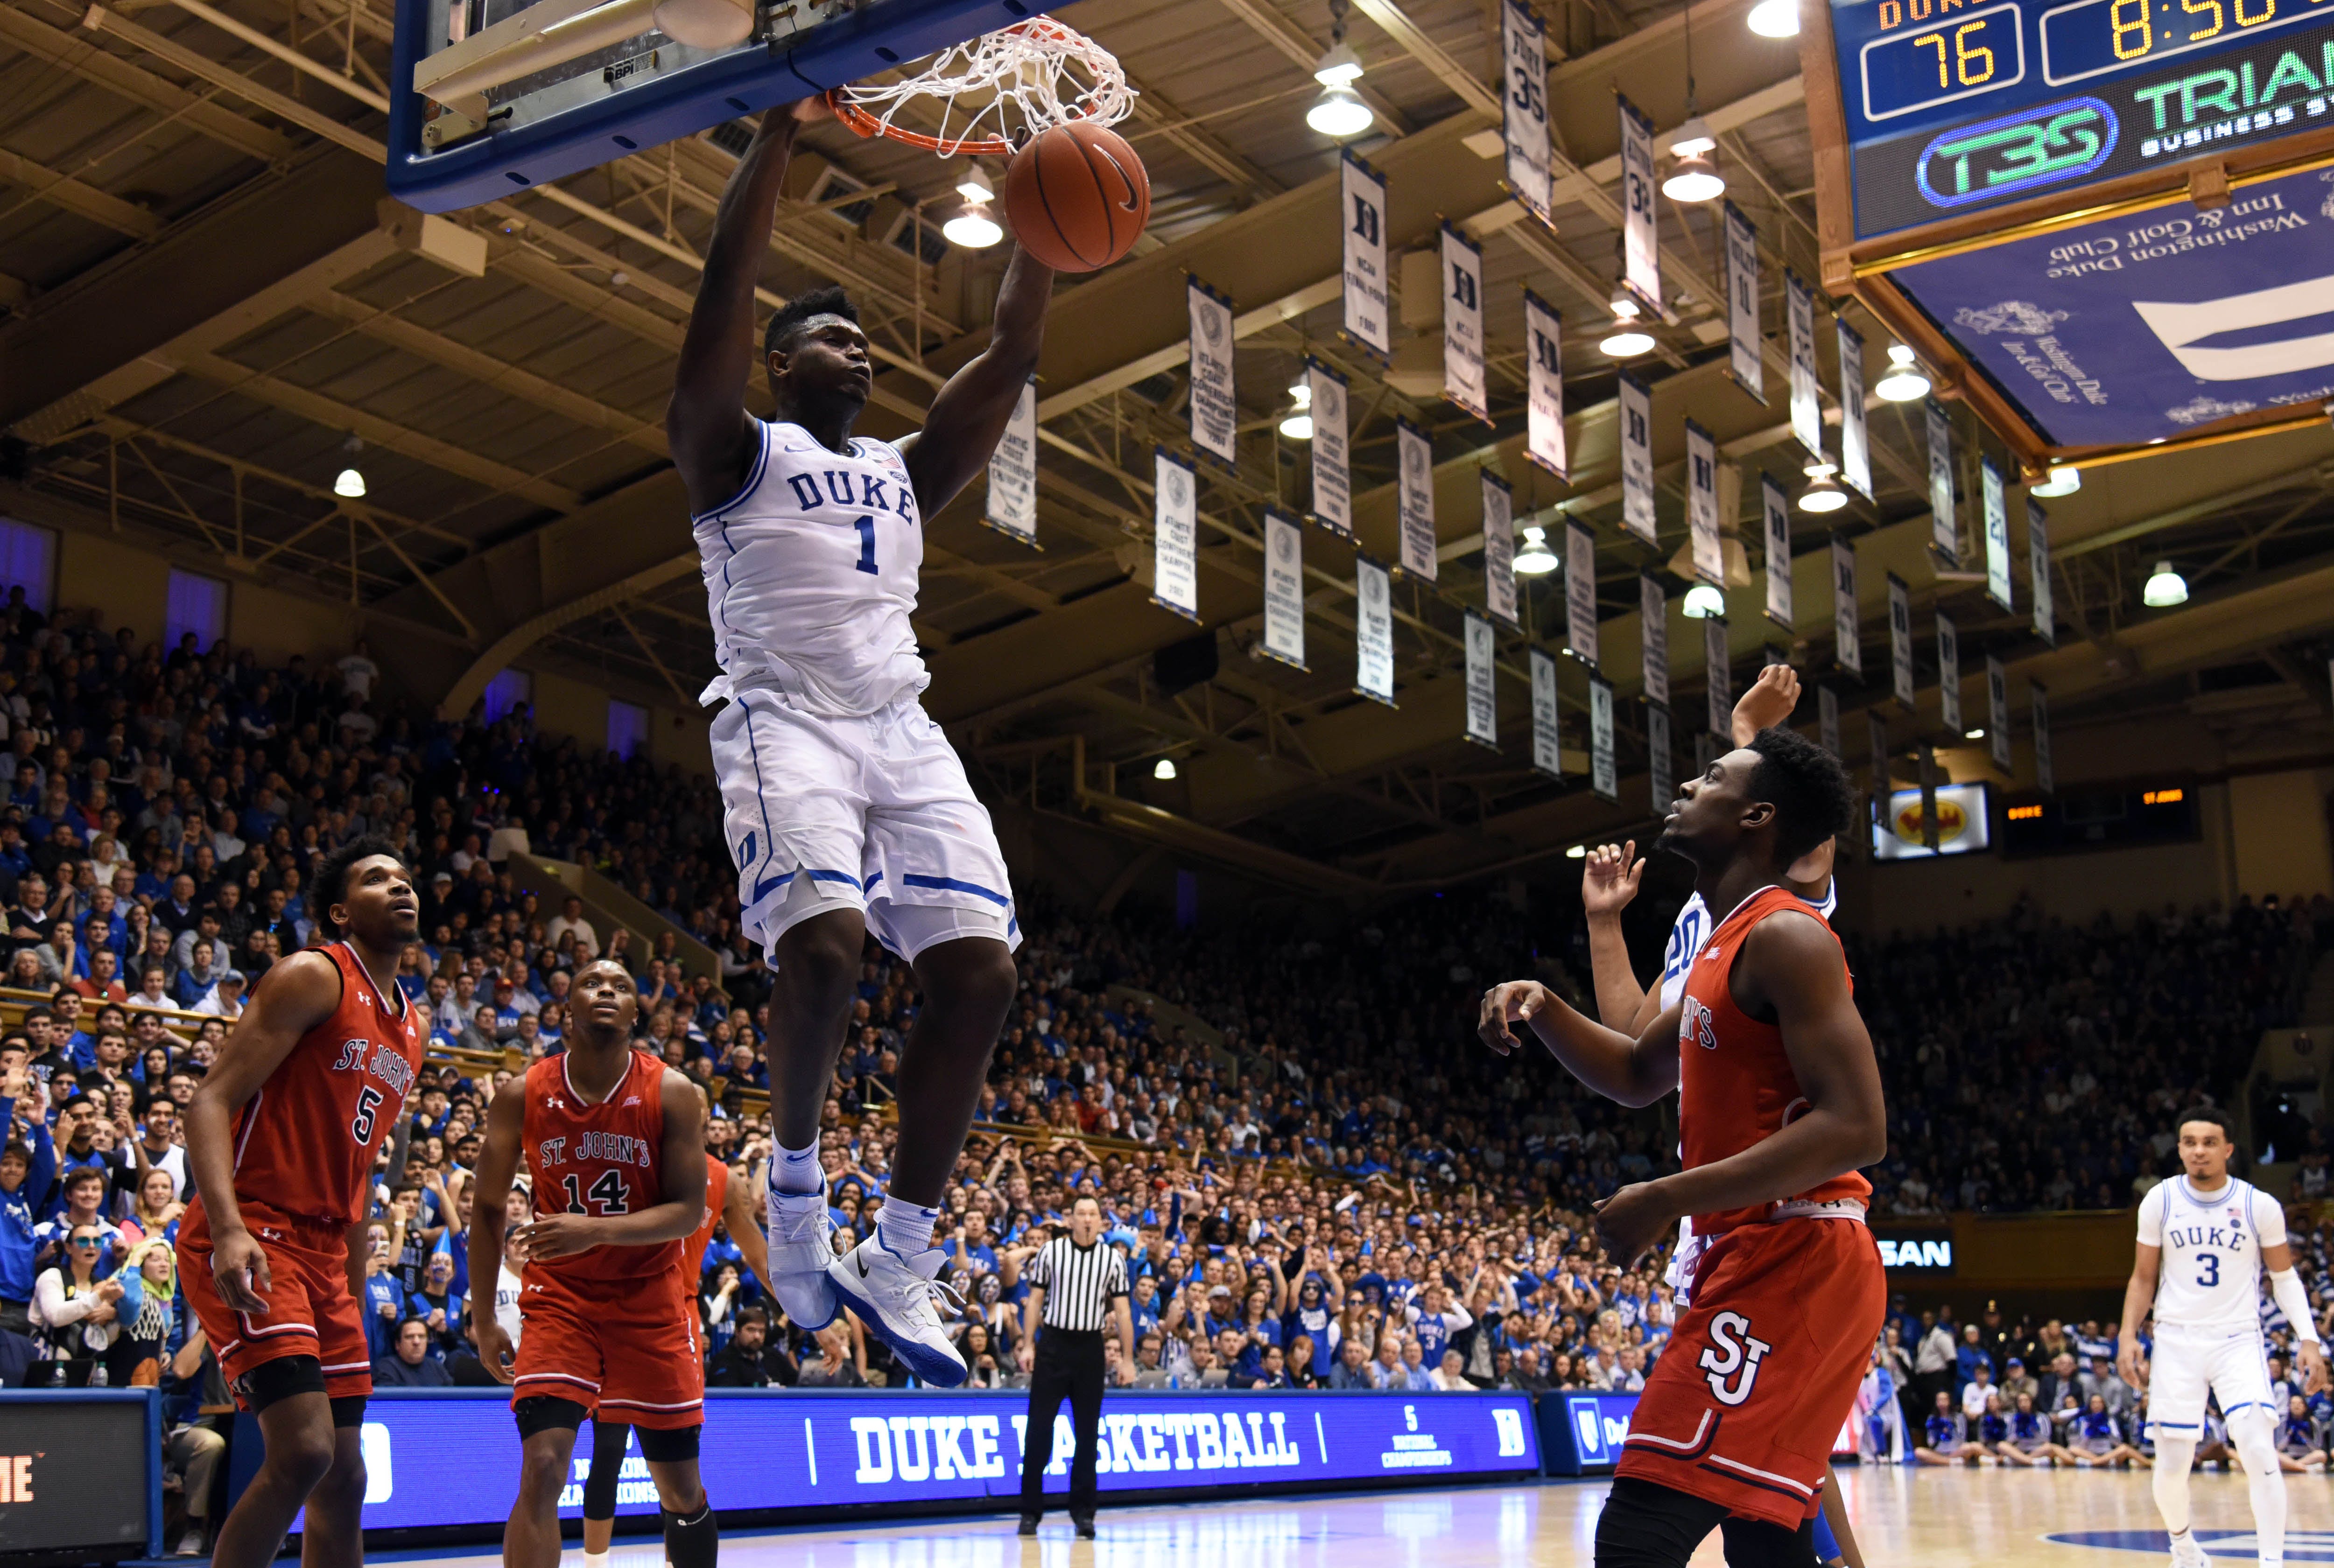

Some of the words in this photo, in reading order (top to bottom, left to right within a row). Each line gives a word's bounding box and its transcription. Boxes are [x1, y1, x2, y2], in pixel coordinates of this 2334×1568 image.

[1914, 21, 1994, 88] 76
[2141, 105, 2294, 157] BUSINESS
[2195, 208, 2224, 228] &
[2231, 193, 2287, 216] Inn
[2050, 237, 2119, 262] Club
[2127, 218, 2193, 249] Golf
[2131, 211, 2310, 262] Washington
[2046, 255, 2125, 279] Duke
[2075, 379, 2109, 405] Duke
[787, 470, 914, 526] DUKE
[854, 515, 879, 576] 1
[1663, 909, 1700, 984] 20
[332, 1039, 368, 1071] ST.
[352, 1085, 384, 1146] 5
[540, 1137, 566, 1169] ST.
[576, 1131, 650, 1167] JOHN'S
[562, 1169, 630, 1217] 14
[2170, 1226, 2246, 1253] DUKE
[2196, 1253, 2220, 1287] 3
[497, 1290, 519, 1306] DU
[1404, 1405, 1418, 1431] 5
[851, 1414, 1005, 1484] DUKE
[1011, 1410, 1300, 1476] ASKETBALL
